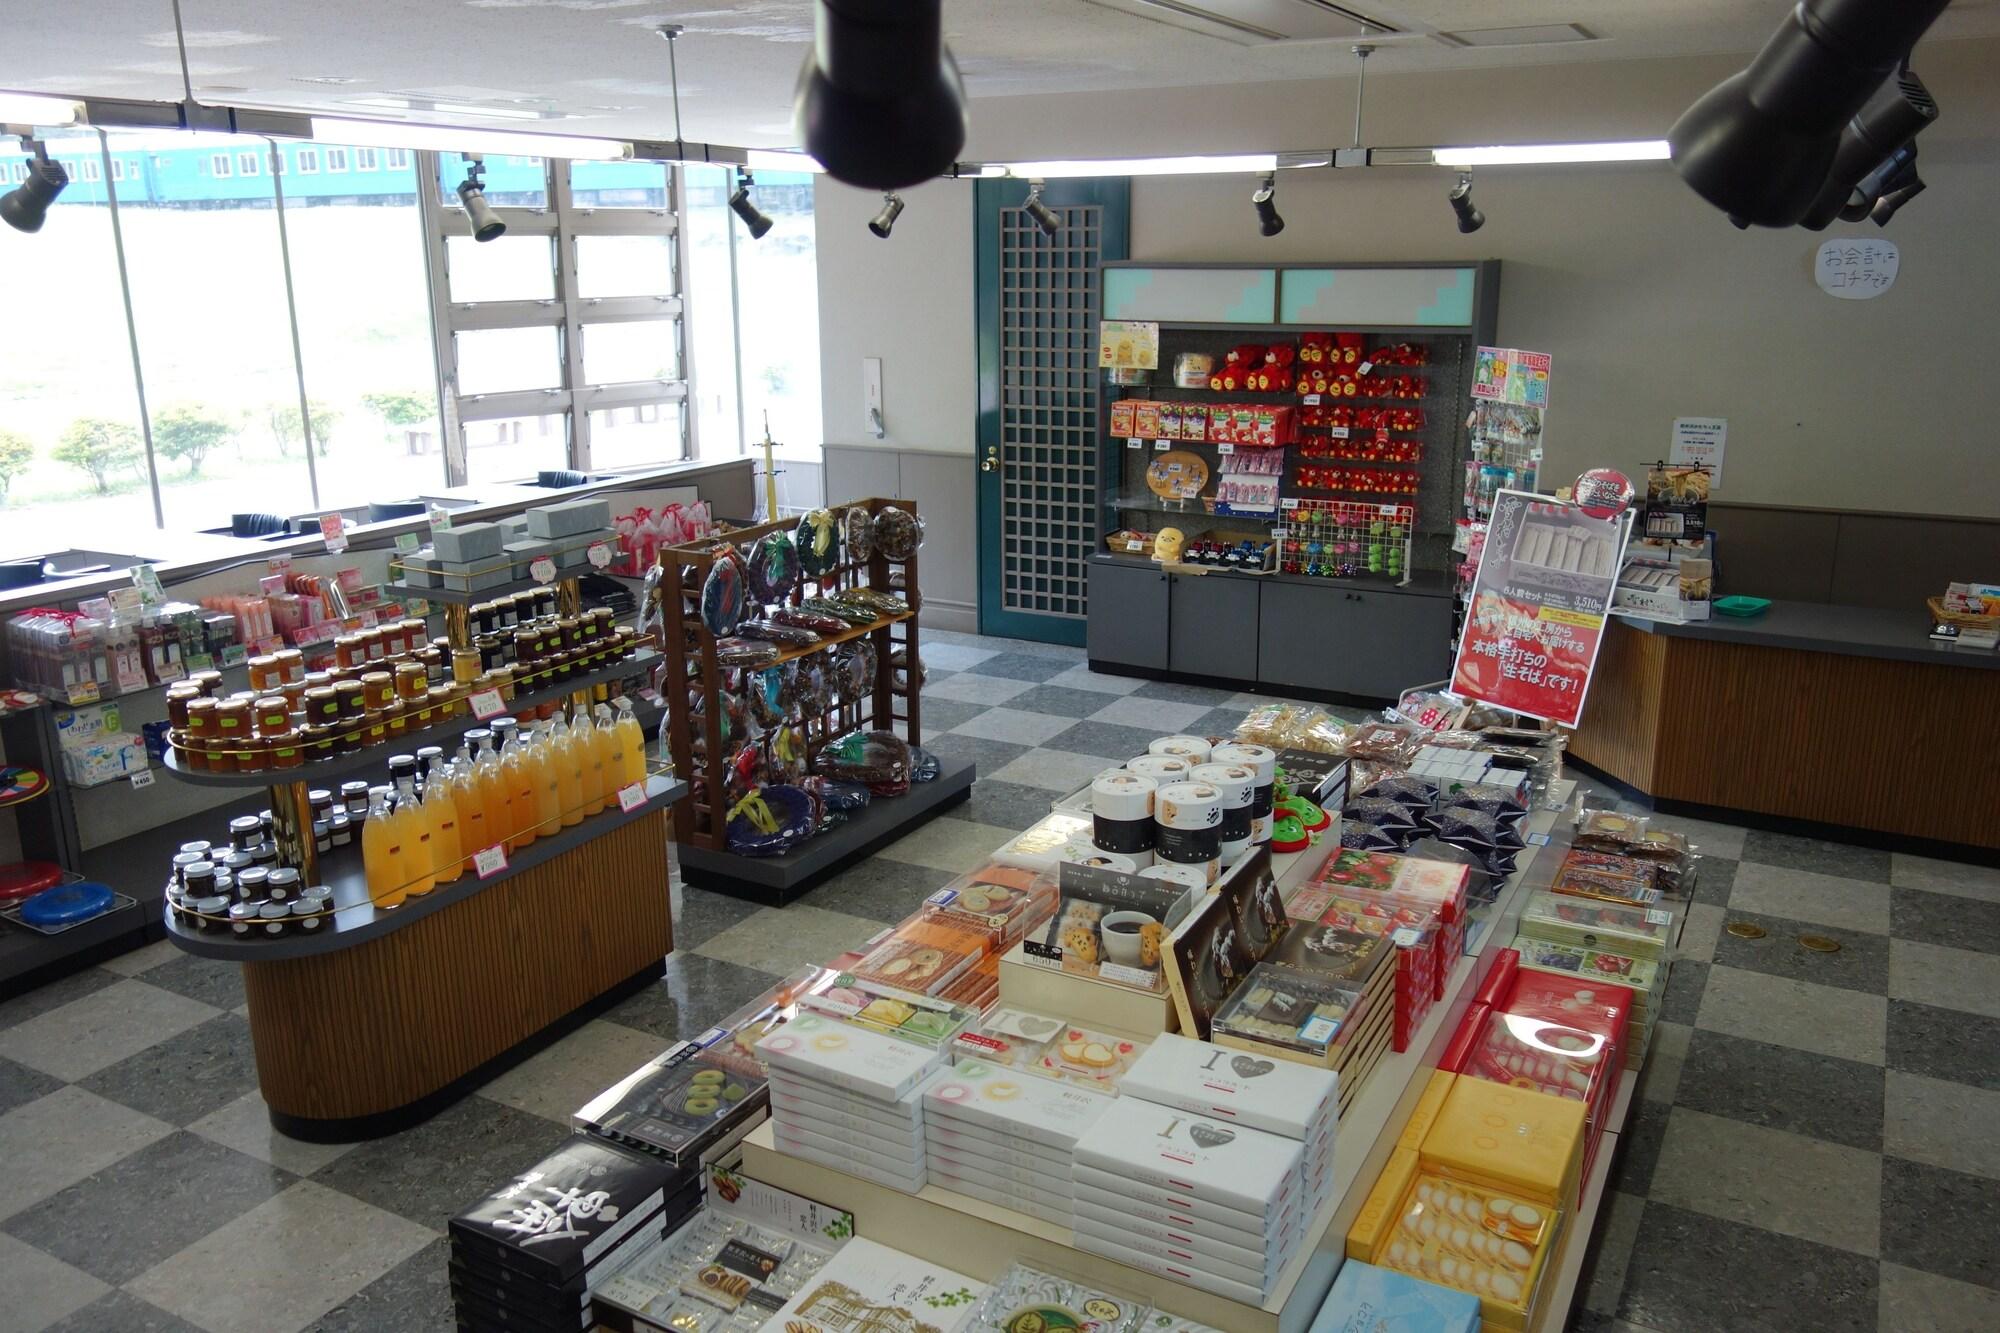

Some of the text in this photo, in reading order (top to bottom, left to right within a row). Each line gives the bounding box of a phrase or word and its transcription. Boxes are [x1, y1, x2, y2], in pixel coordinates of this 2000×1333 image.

[1832, 269, 1889, 288] コチラです
[1471, 638, 1548, 668] 本格手打ちの
[1200, 1049, 1227, 1071] I
[1156, 1115, 1187, 1139] I
